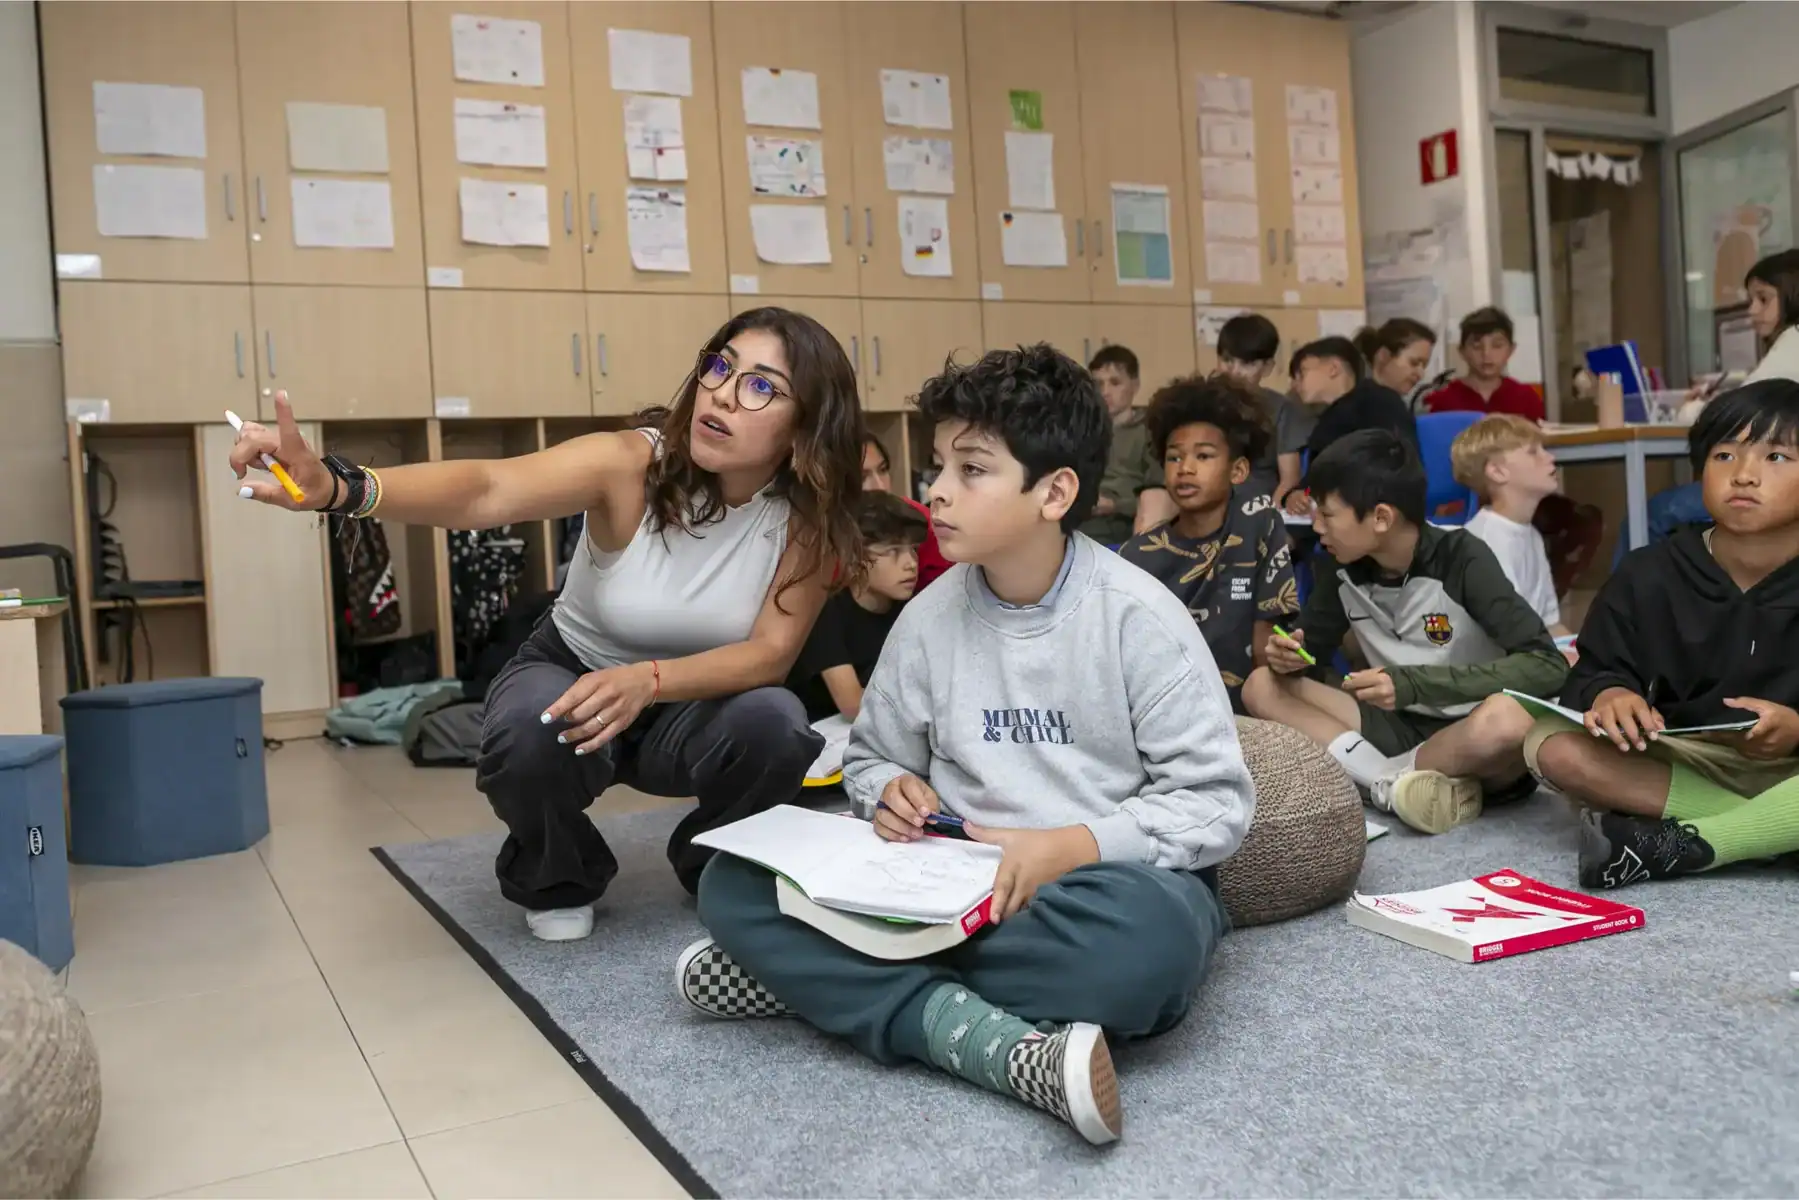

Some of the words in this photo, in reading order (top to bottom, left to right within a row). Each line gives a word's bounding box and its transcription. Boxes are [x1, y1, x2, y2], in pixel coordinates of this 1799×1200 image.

[1231, 585, 1246, 593] FROM
[981, 707, 1071, 728] MINIMAL
[983, 726, 1001, 742] &
[1011, 726, 1074, 744] CHILL
[31, 829, 41, 853] IKEA
[1592, 921, 1614, 931] STUDENT
[1614, 918, 1629, 927] BOOK
[1479, 943, 1503, 955] BRIDGES
